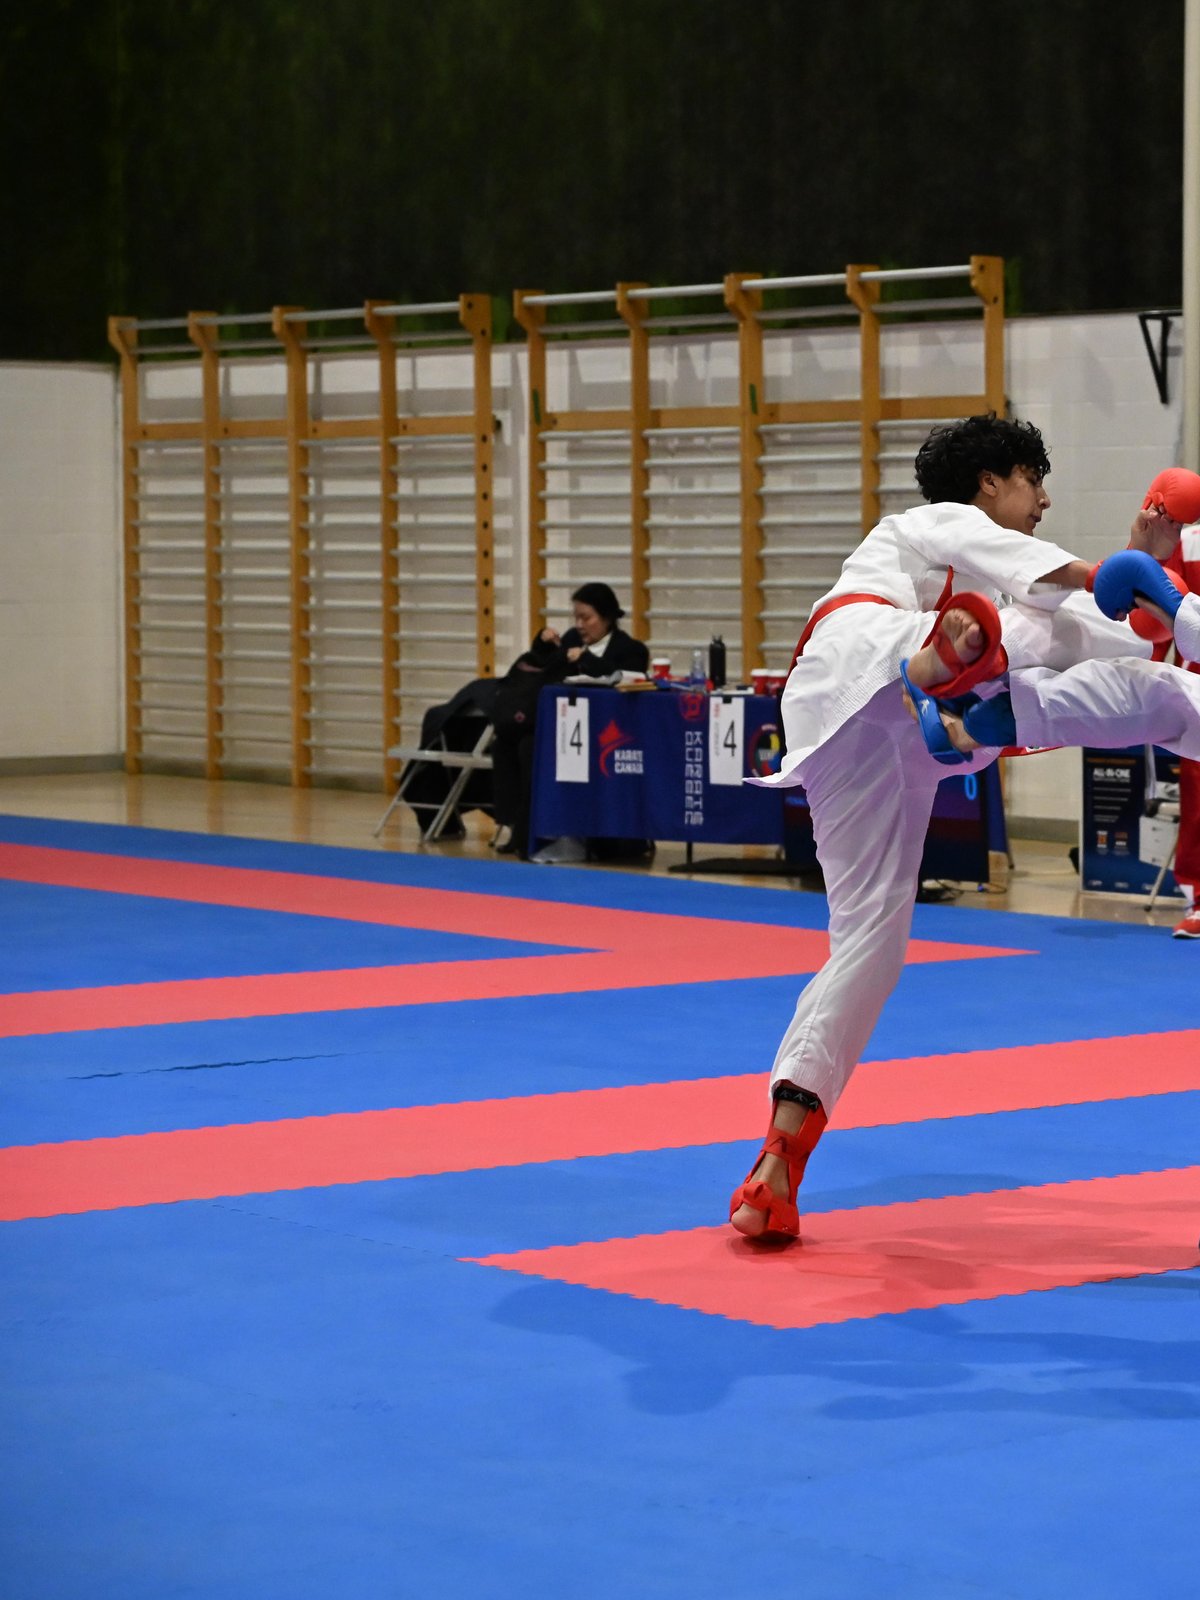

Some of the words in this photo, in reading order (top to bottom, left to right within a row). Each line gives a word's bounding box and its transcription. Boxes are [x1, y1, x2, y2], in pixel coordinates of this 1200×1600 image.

[569, 720, 583, 756] 4
[723, 720, 737, 757] 4
[965, 774, 977, 800] 0
